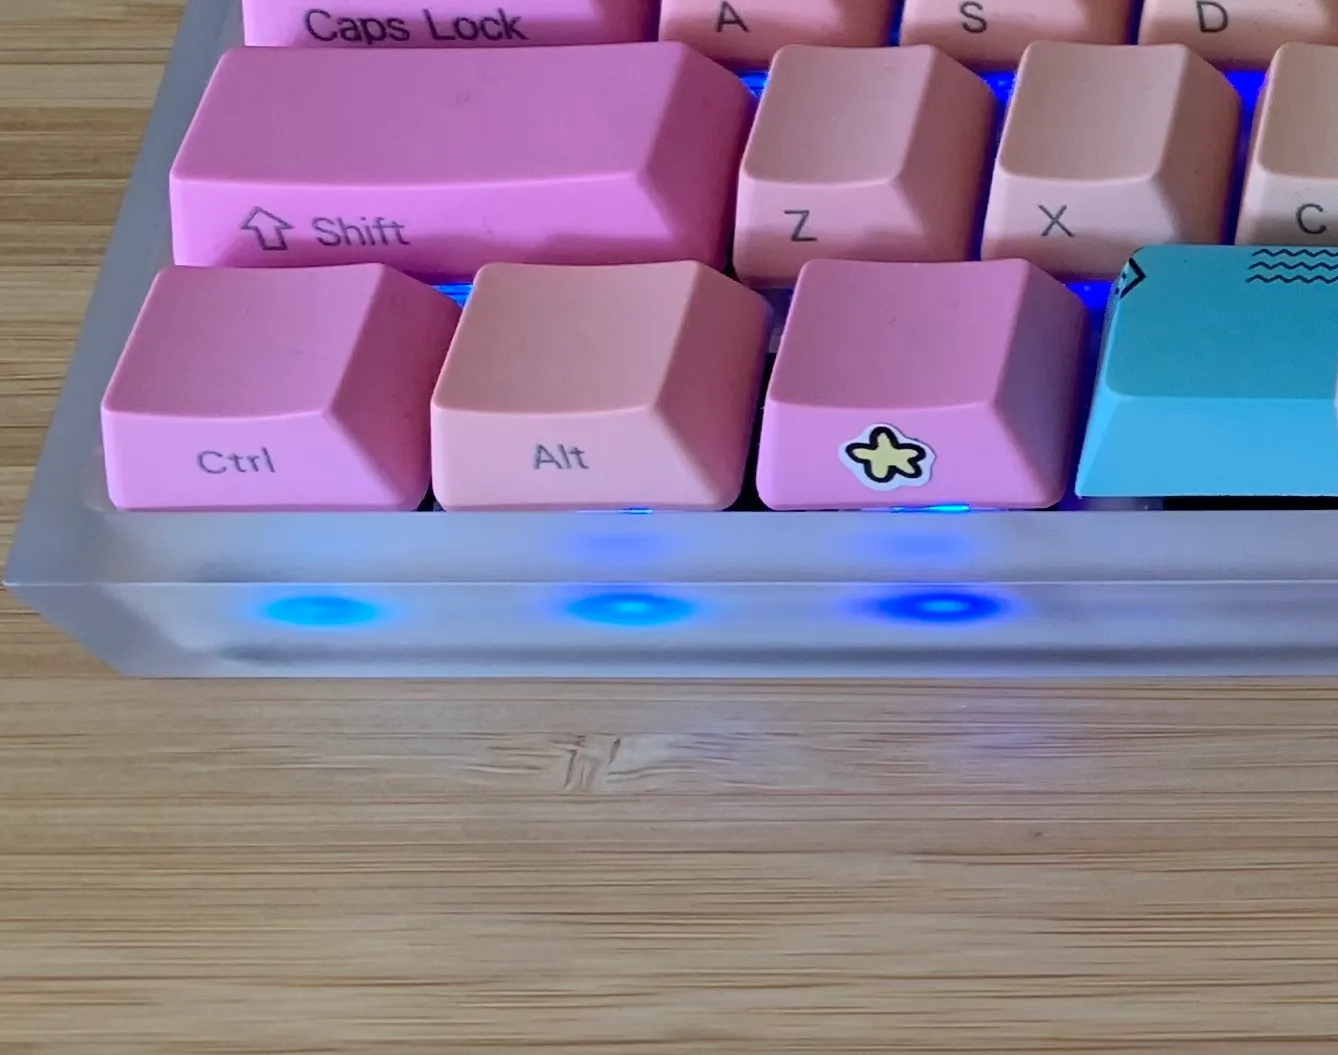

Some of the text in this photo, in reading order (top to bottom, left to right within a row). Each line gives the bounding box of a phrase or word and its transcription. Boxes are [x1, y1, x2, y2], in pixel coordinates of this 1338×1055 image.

[303, 7, 530, 47] Caps Lock
[716, 0, 750, 33] A
[959, 0, 988, 34] S
[1195, 0, 1229, 34] D
[311, 216, 411, 247] Shift
[783, 209, 818, 243] Z
[1037, 204, 1075, 238] X
[1295, 202, 1327, 235] C
[197, 446, 276, 475] Ctrl
[534, 443, 590, 470] Alt
